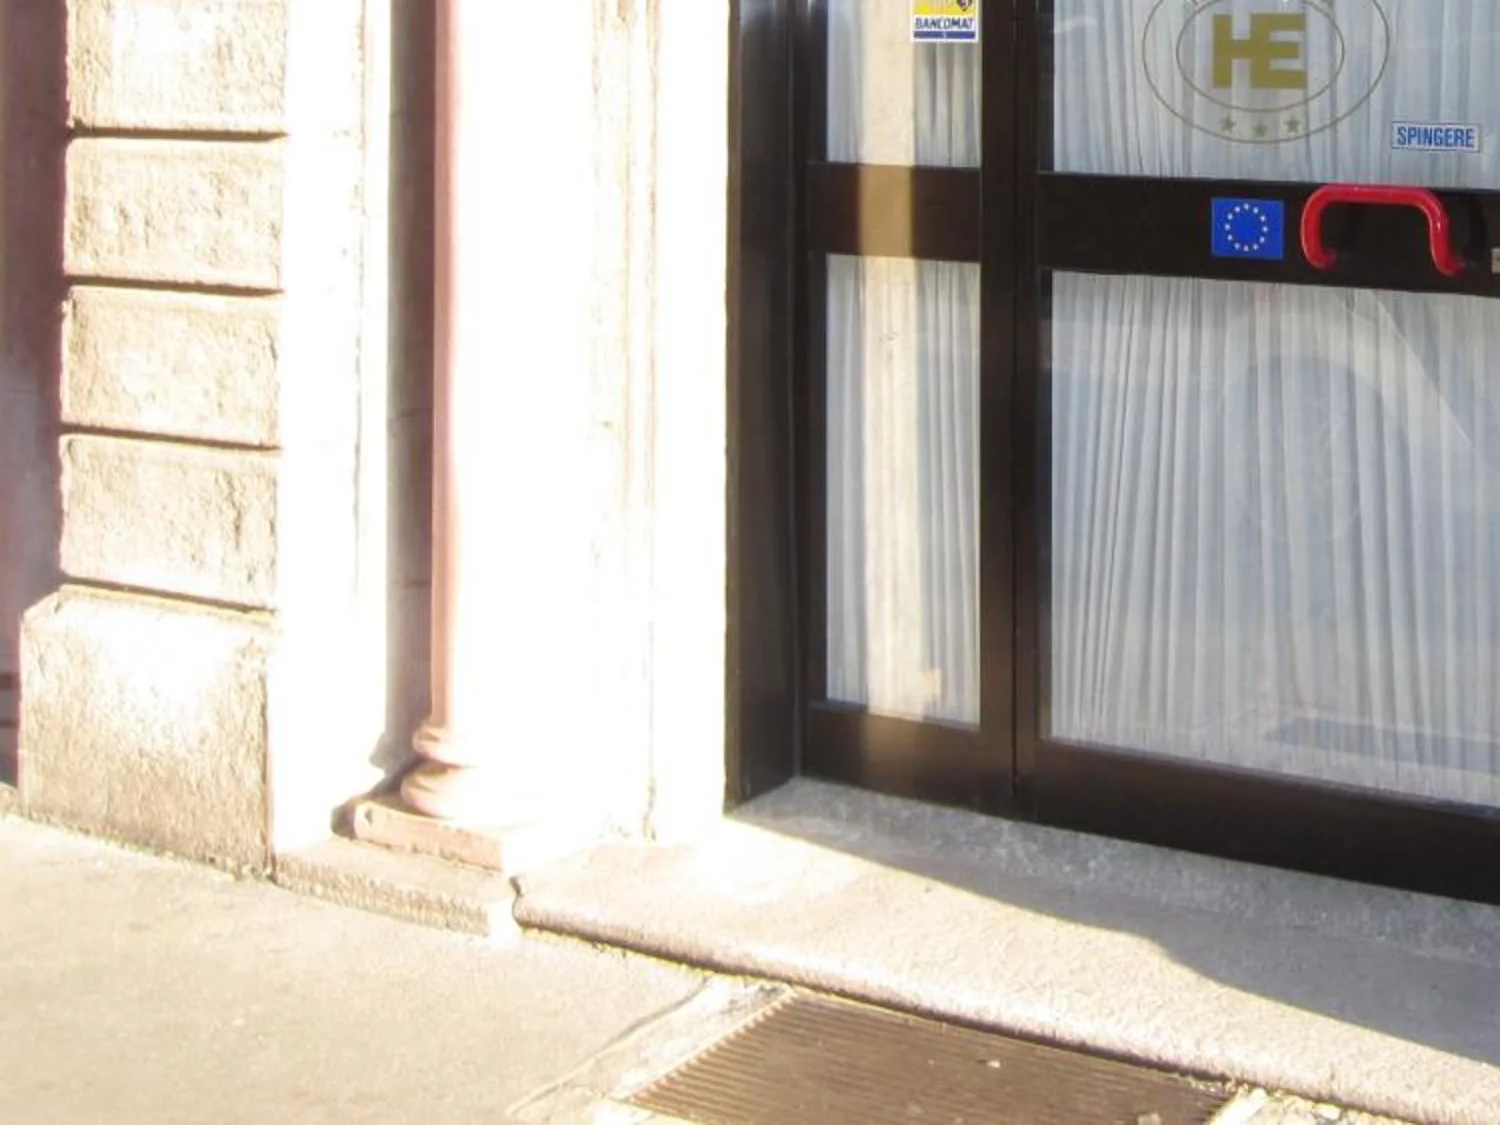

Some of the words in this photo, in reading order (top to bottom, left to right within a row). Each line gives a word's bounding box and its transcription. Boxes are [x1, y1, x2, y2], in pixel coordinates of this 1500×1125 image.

[914, 16, 974, 30] BANCOMAT
[1212, 13, 1308, 89] HE
[1396, 126, 1475, 149] SPINGERE
